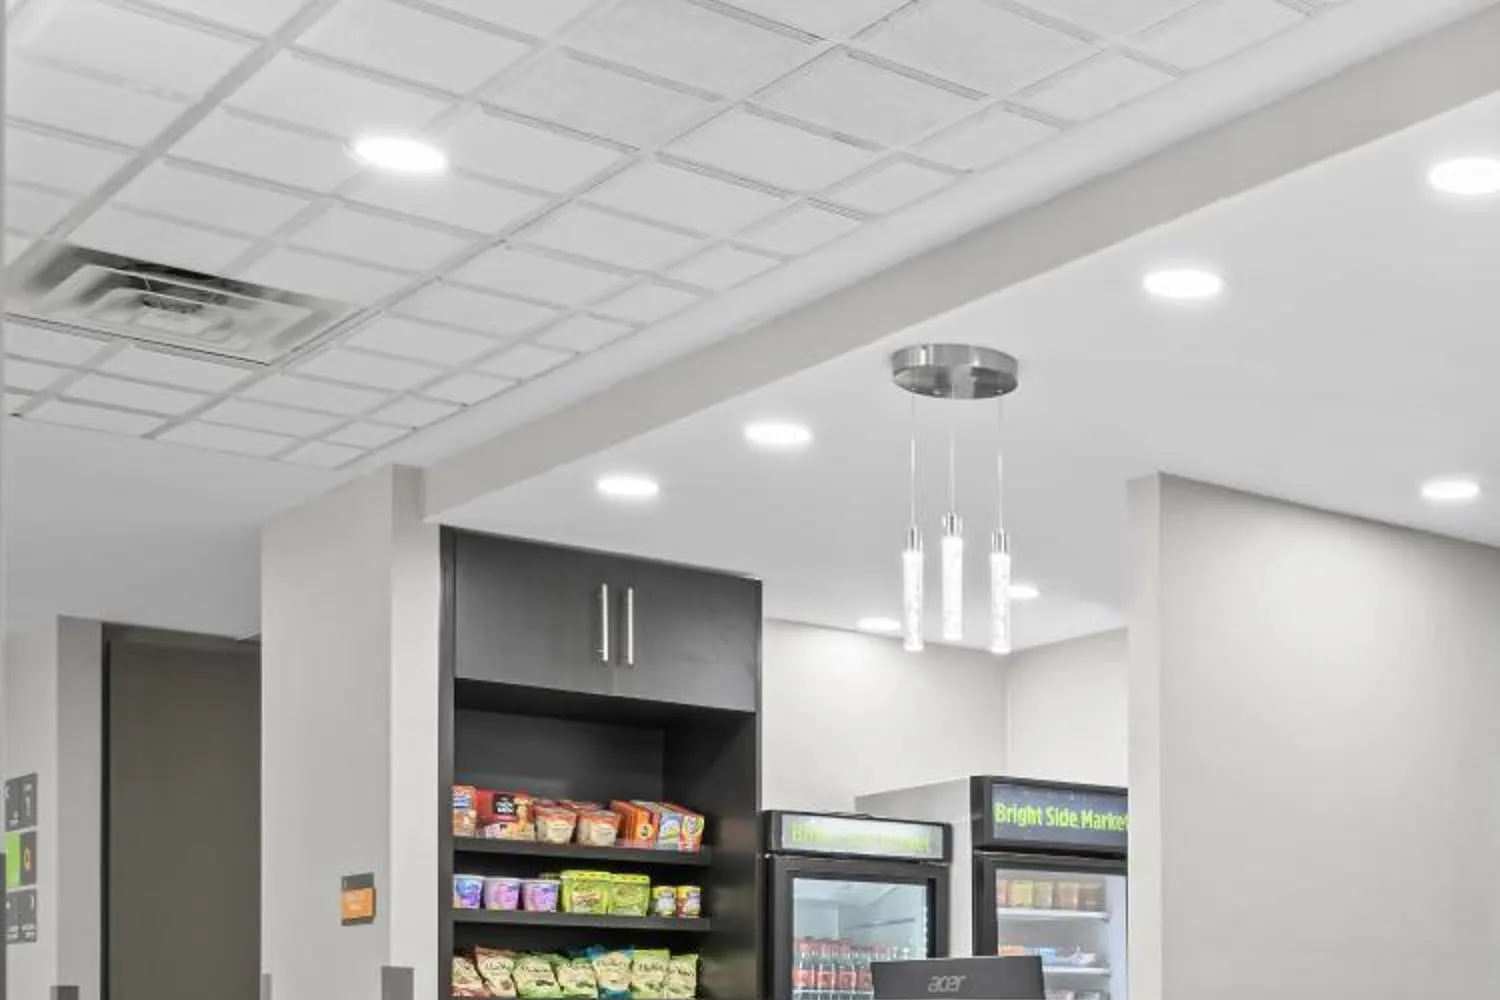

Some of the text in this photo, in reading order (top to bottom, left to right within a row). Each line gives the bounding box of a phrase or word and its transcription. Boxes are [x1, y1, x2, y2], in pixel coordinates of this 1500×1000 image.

[994, 801, 1043, 828] Bright
[1045, 805, 1079, 829] Side
[927, 975, 968, 993] acer
